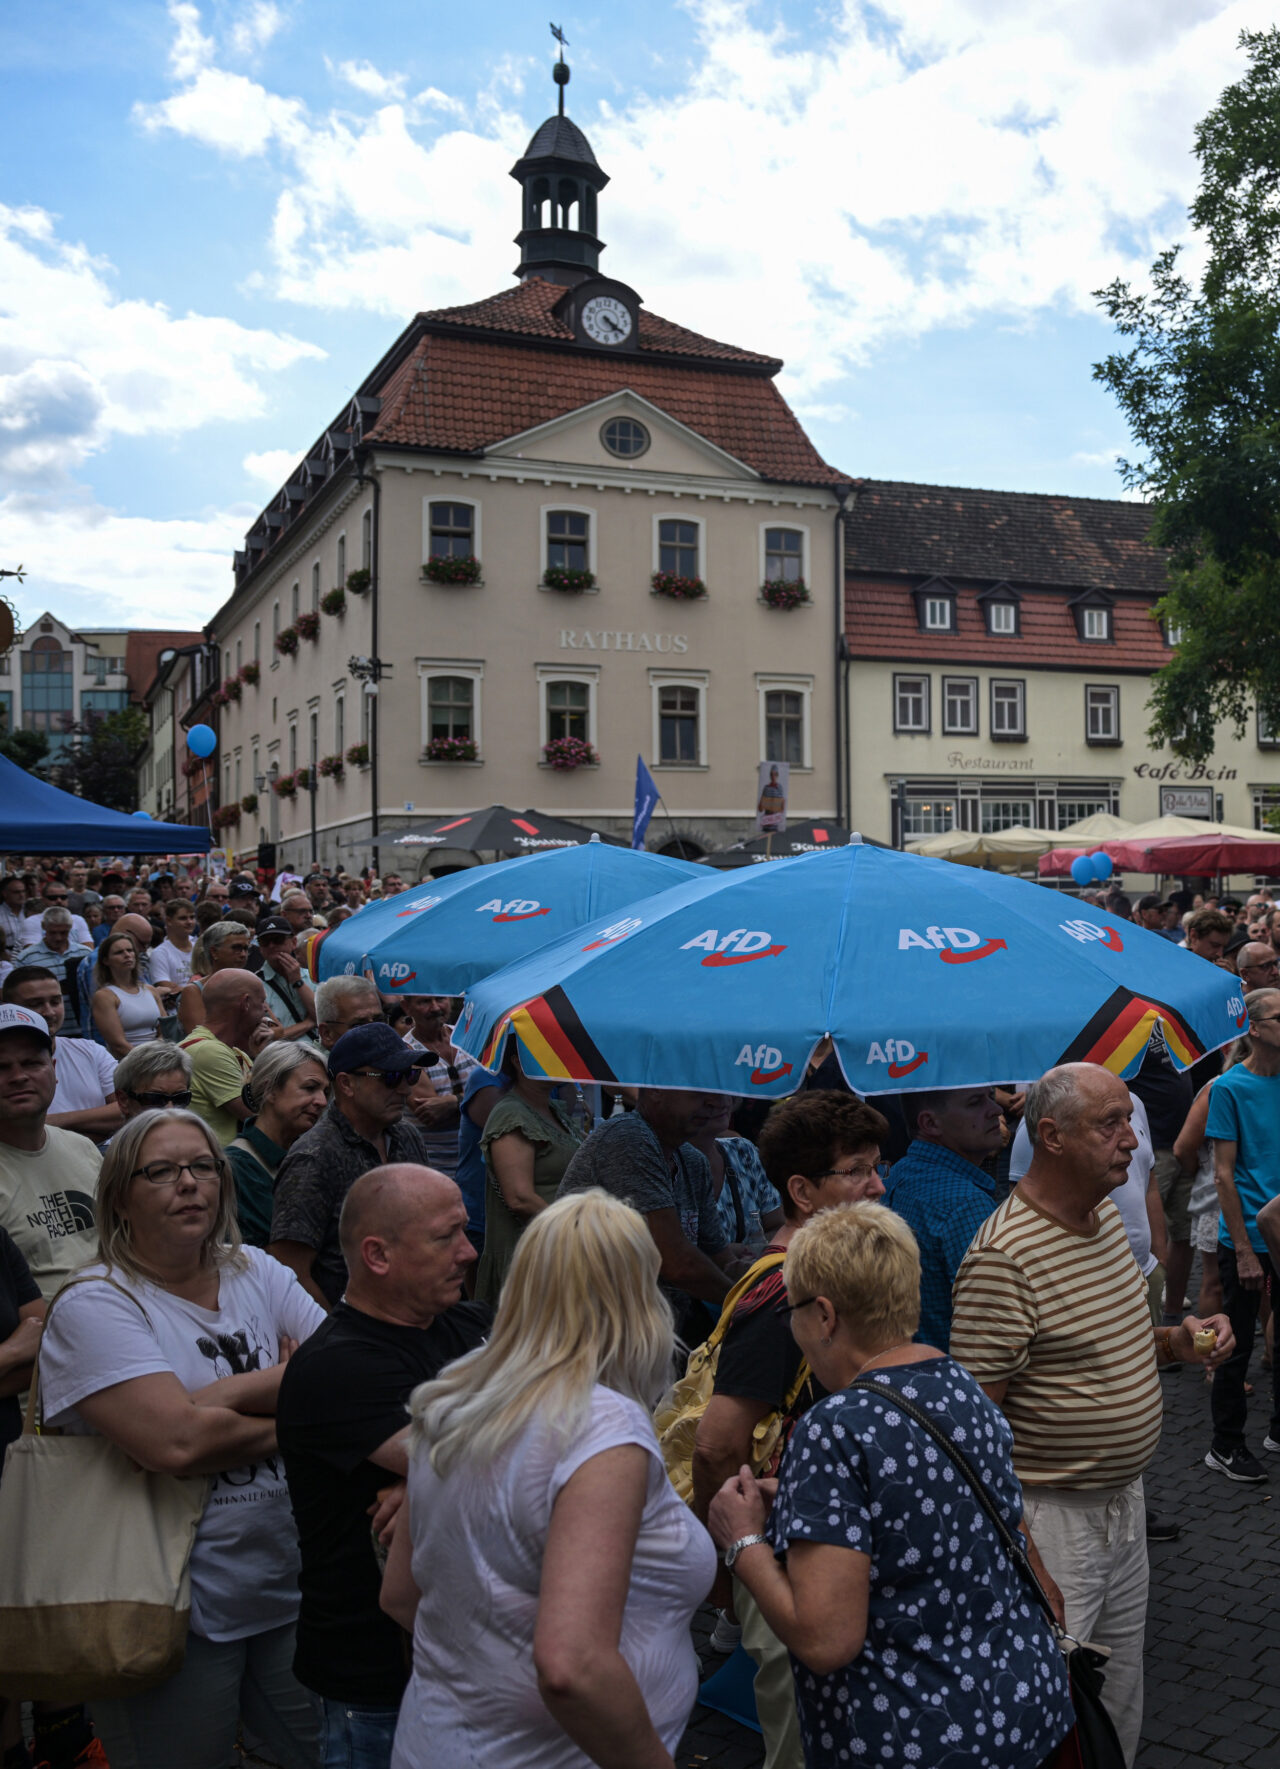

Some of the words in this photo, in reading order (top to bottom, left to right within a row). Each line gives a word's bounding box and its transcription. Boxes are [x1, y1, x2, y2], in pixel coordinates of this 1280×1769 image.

[560, 629, 689, 653] RATHAUS
[947, 751, 1034, 770] Restaurant
[1184, 763, 1237, 781] Bein
[475, 898, 541, 914] AfD
[596, 917, 643, 940] AfD
[898, 926, 981, 949] AfD
[1058, 919, 1106, 944] AfD
[680, 928, 772, 953] AfD
[379, 962, 410, 978] AfD
[1226, 996, 1243, 1019] AfD
[735, 1043, 783, 1070] AfD
[866, 1038, 916, 1065] AfD
[39, 1191, 67, 1210] THE
[26, 1205, 72, 1228] NORTH
[46, 1220, 76, 1239] FACE
